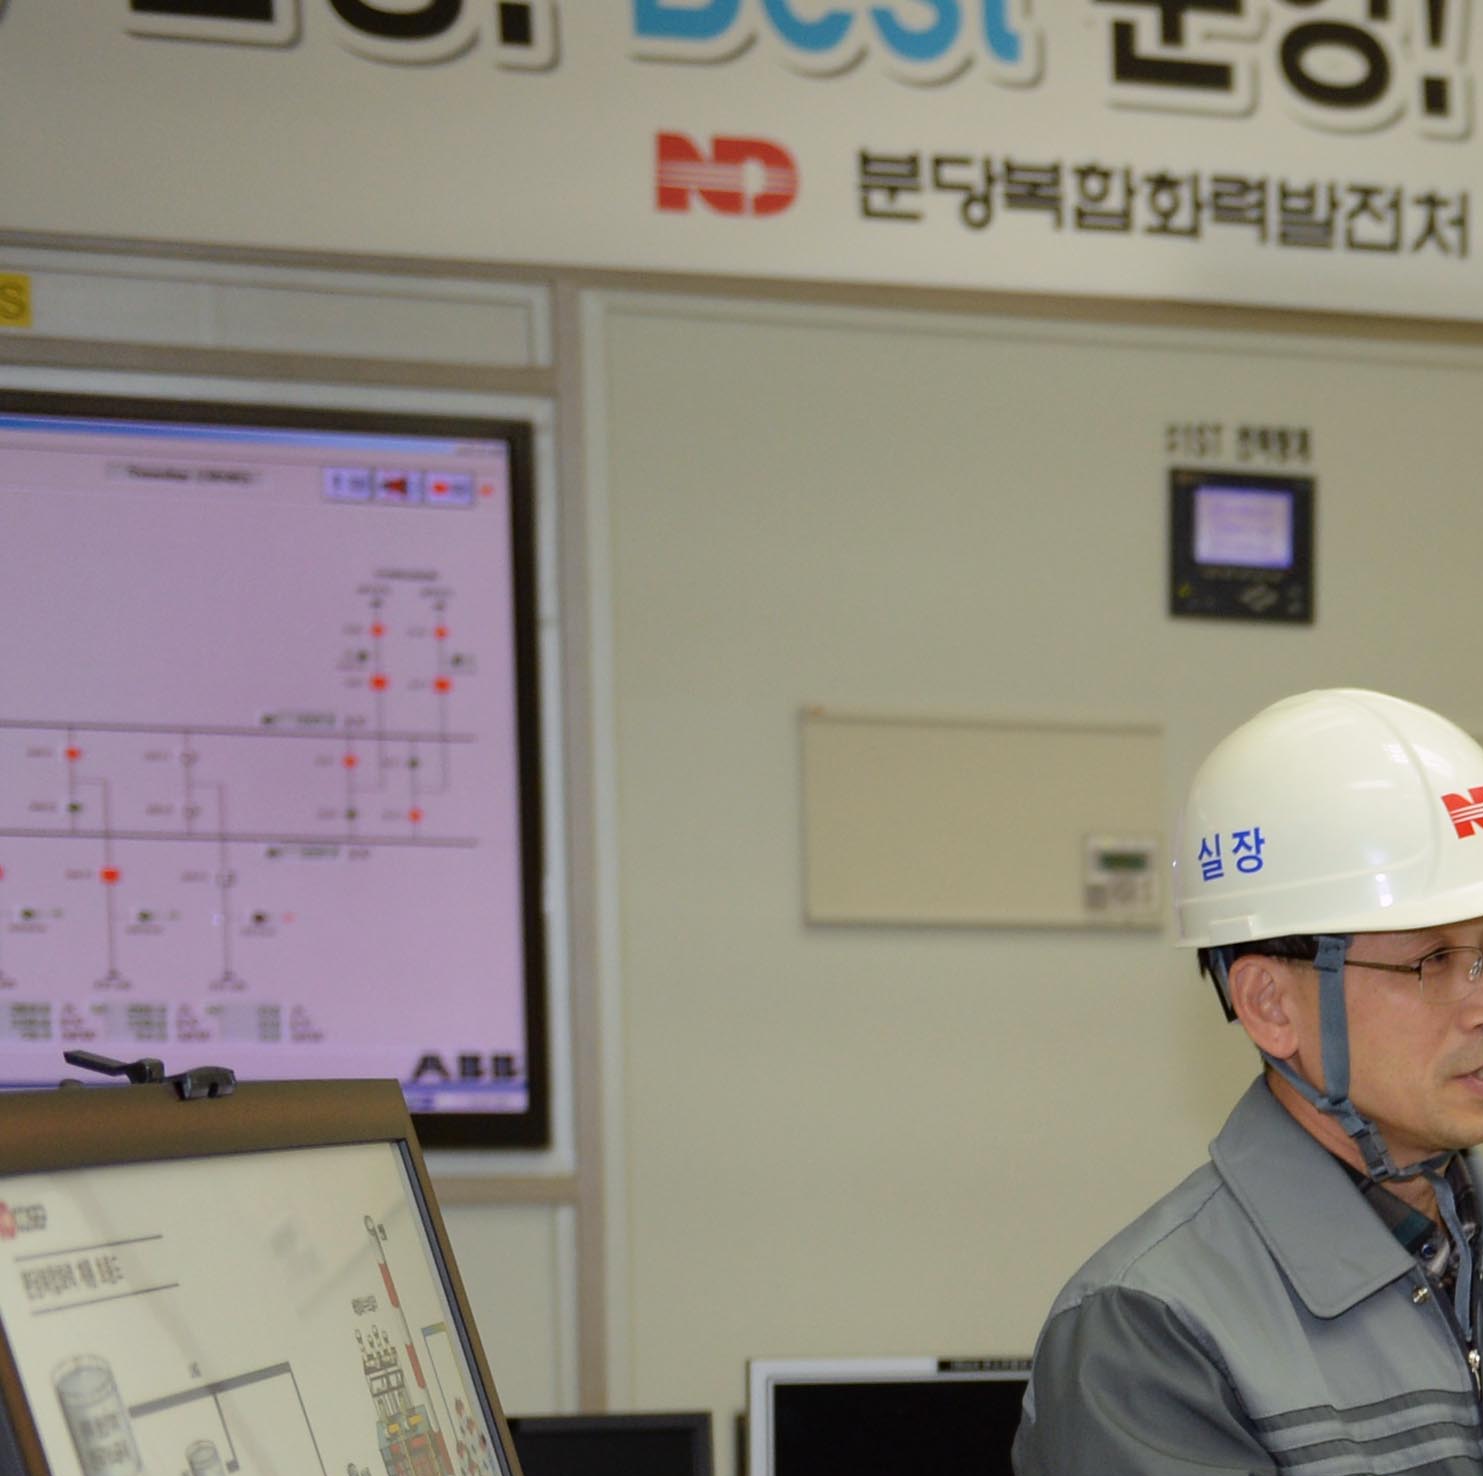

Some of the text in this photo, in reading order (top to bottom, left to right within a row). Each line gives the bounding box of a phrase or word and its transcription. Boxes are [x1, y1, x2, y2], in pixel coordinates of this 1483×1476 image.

[634, 0, 1020, 63] es
[858, 149, 1469, 260] 분당복합화력발전처
[1198, 827, 1265, 882] 실장
[412, 1051, 521, 1079] ABB
